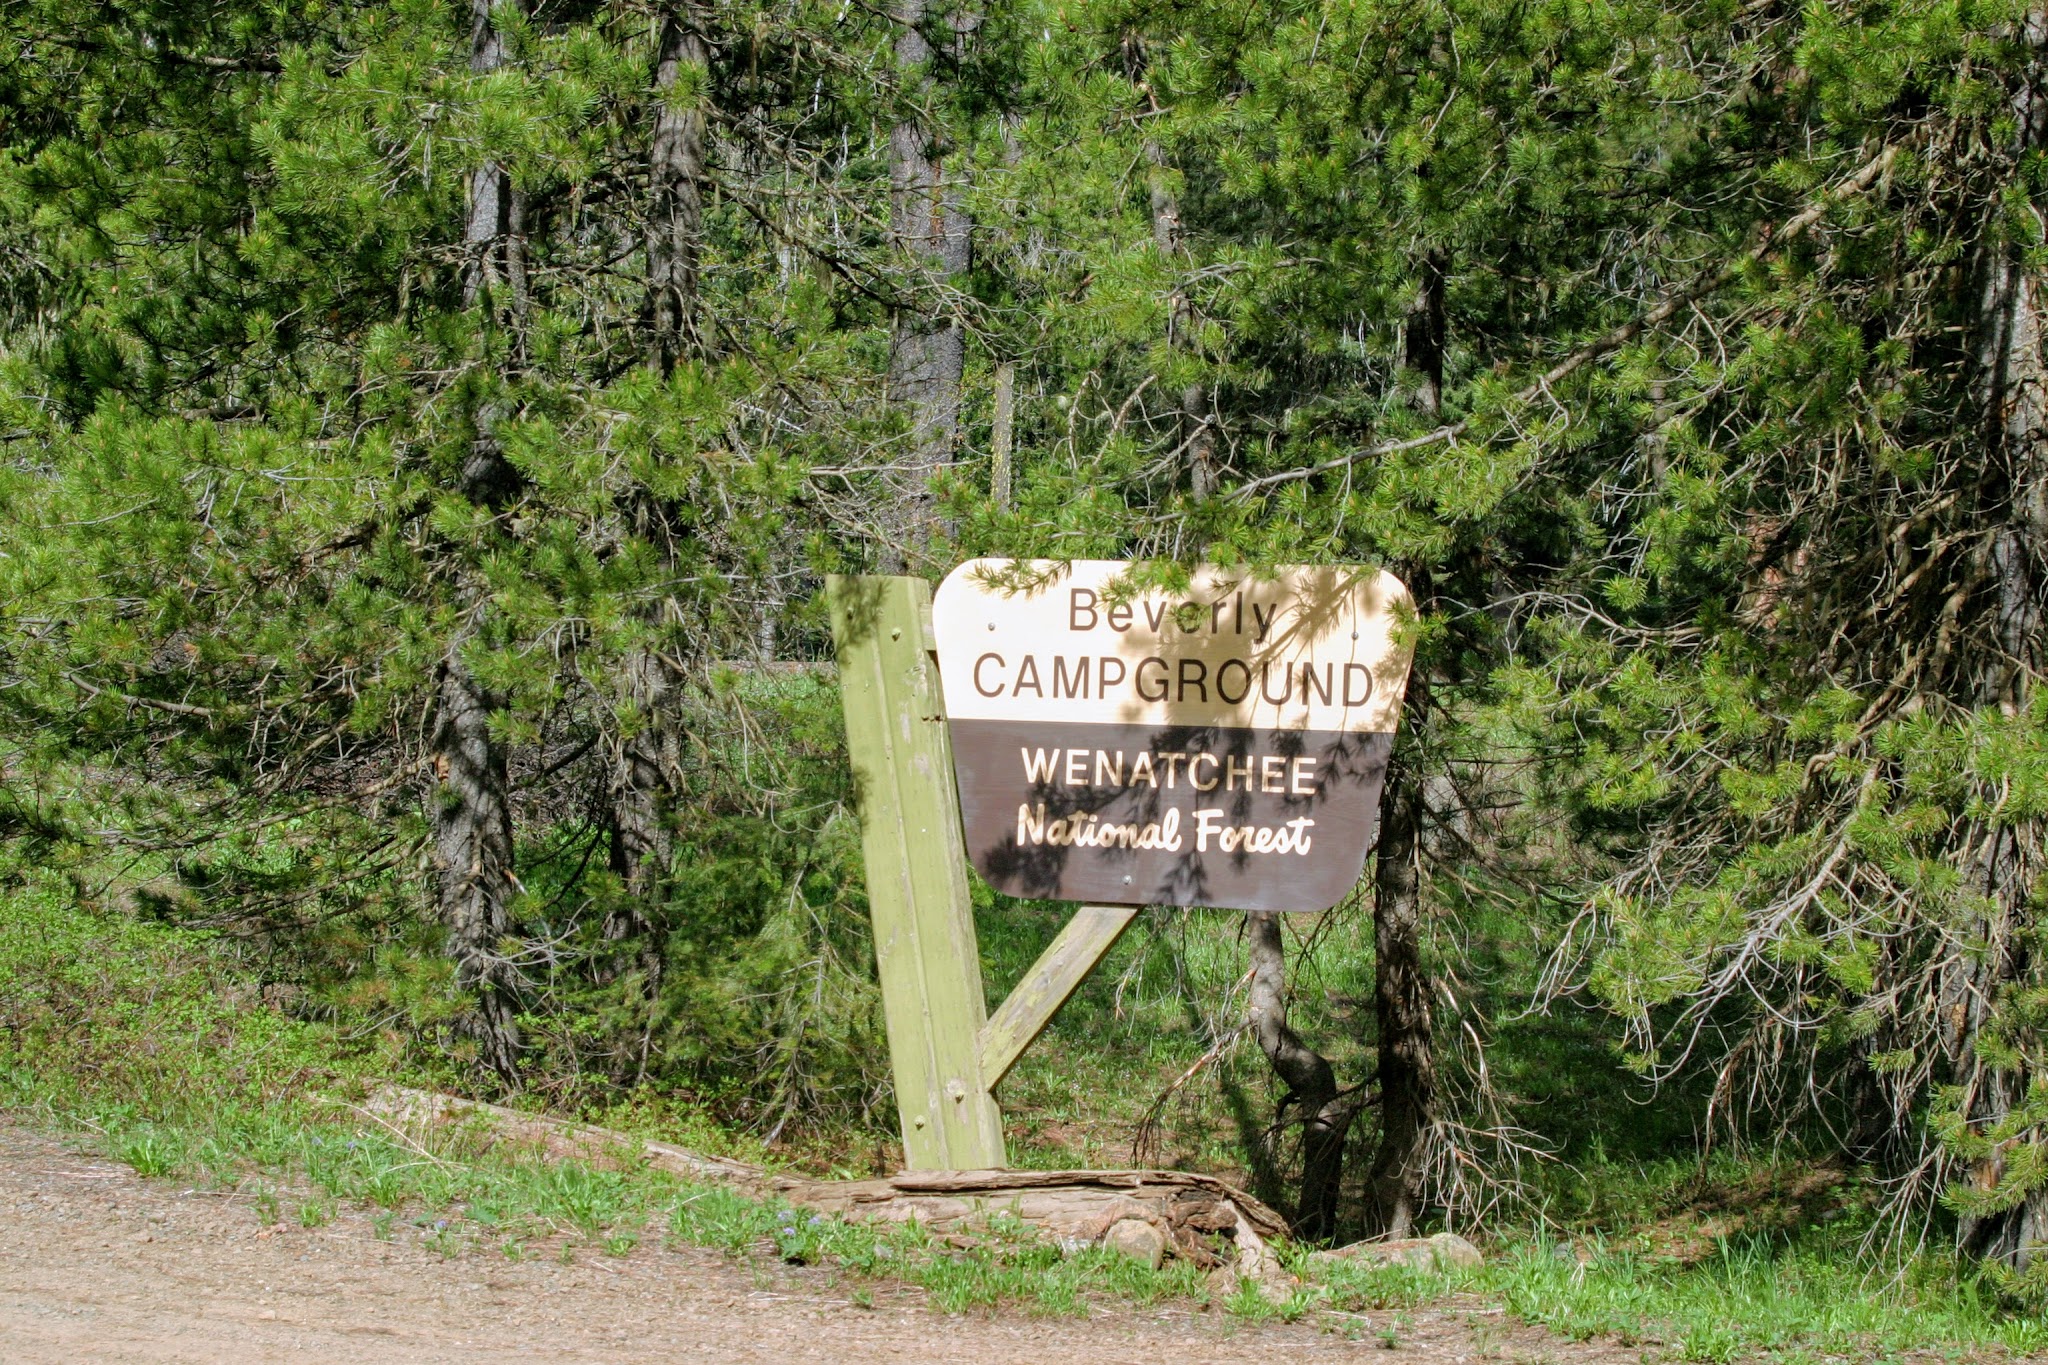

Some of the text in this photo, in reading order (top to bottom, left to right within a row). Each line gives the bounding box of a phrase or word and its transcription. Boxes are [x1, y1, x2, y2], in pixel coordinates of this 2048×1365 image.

[1068, 587, 1278, 645] Beverly
[973, 652, 1374, 708] CAMPGROUND
[1020, 746, 1318, 796] WENATCHEE
[1016, 802, 1316, 856] National Forest
